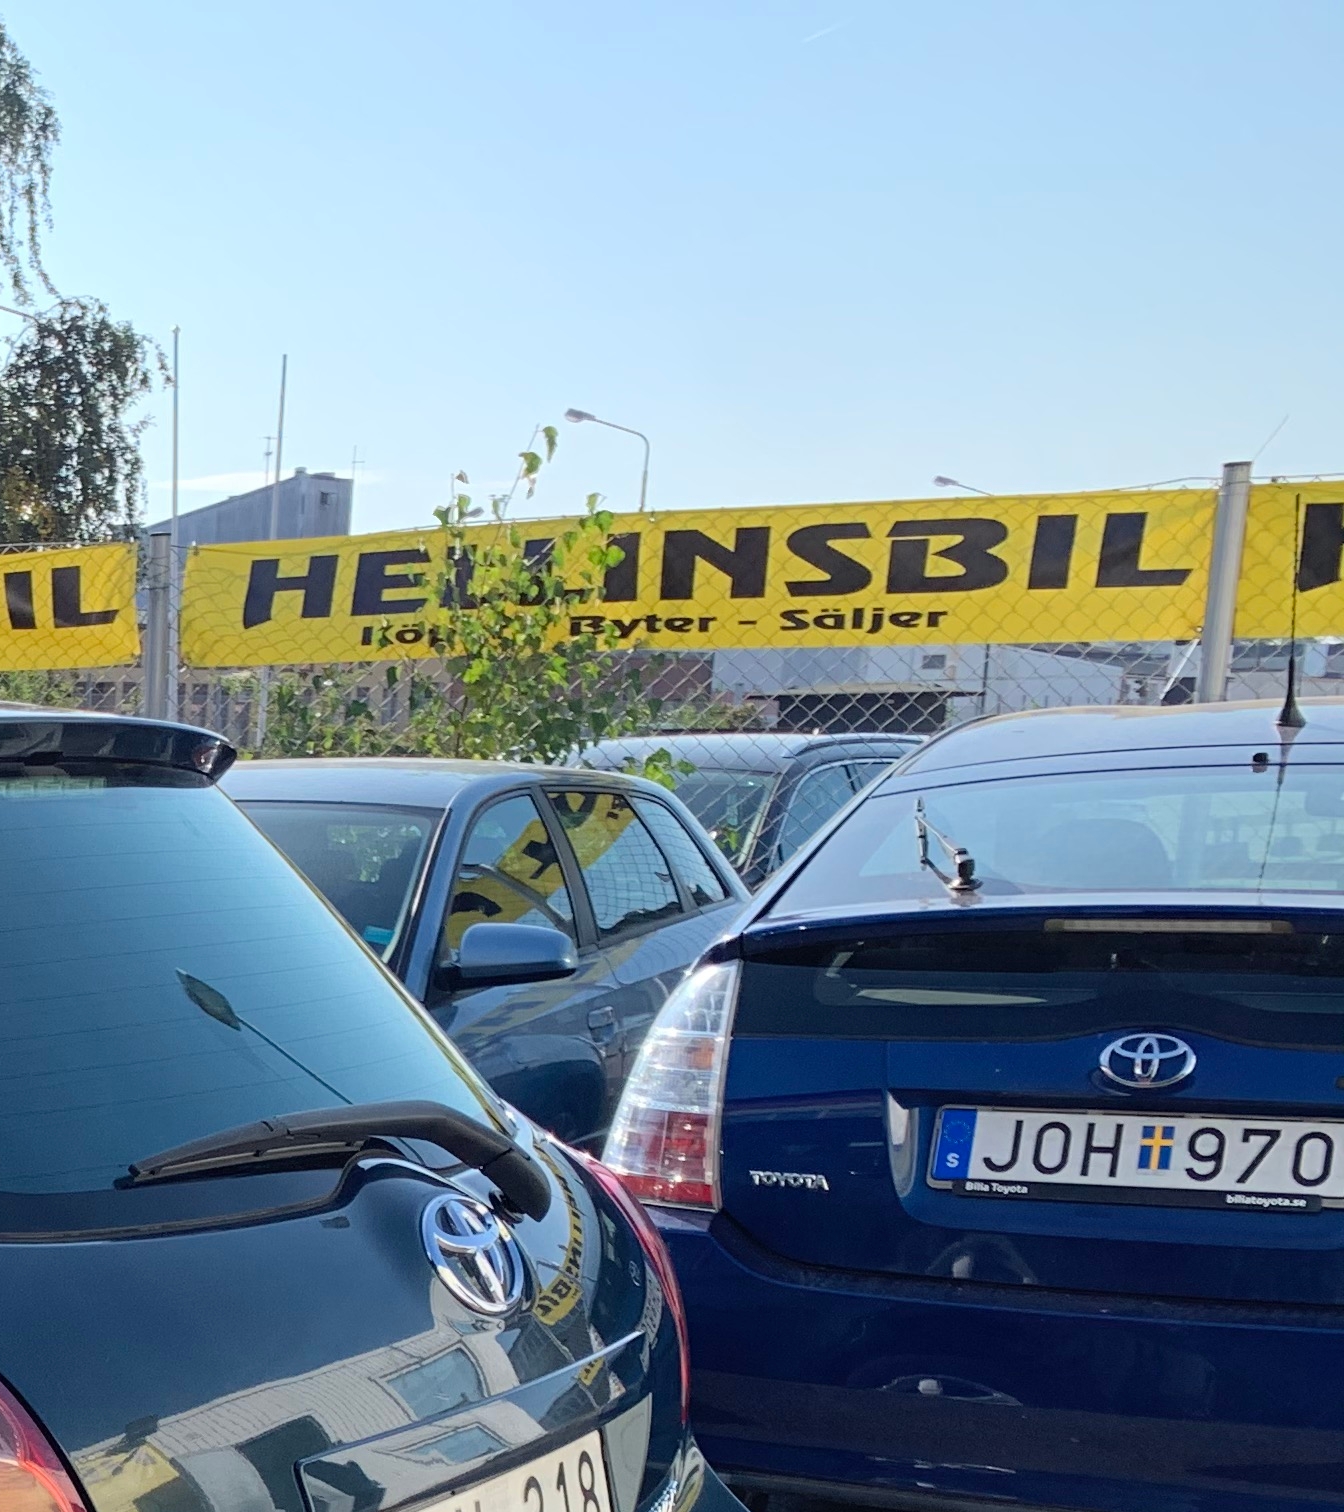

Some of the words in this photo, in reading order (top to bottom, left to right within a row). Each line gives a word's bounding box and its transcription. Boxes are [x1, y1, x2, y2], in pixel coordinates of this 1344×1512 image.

[361, 621, 462, 651] Köp
[570, 614, 717, 639] Byter
[780, 607, 948, 634] Säljer
[946, 1153, 960, 1169] S
[983, 1119, 1124, 1178] JOH
[1185, 1127, 1334, 1188] 970
[749, 1170, 830, 1191] TOYOTA
[991, 1182, 1028, 1195] Toyota
